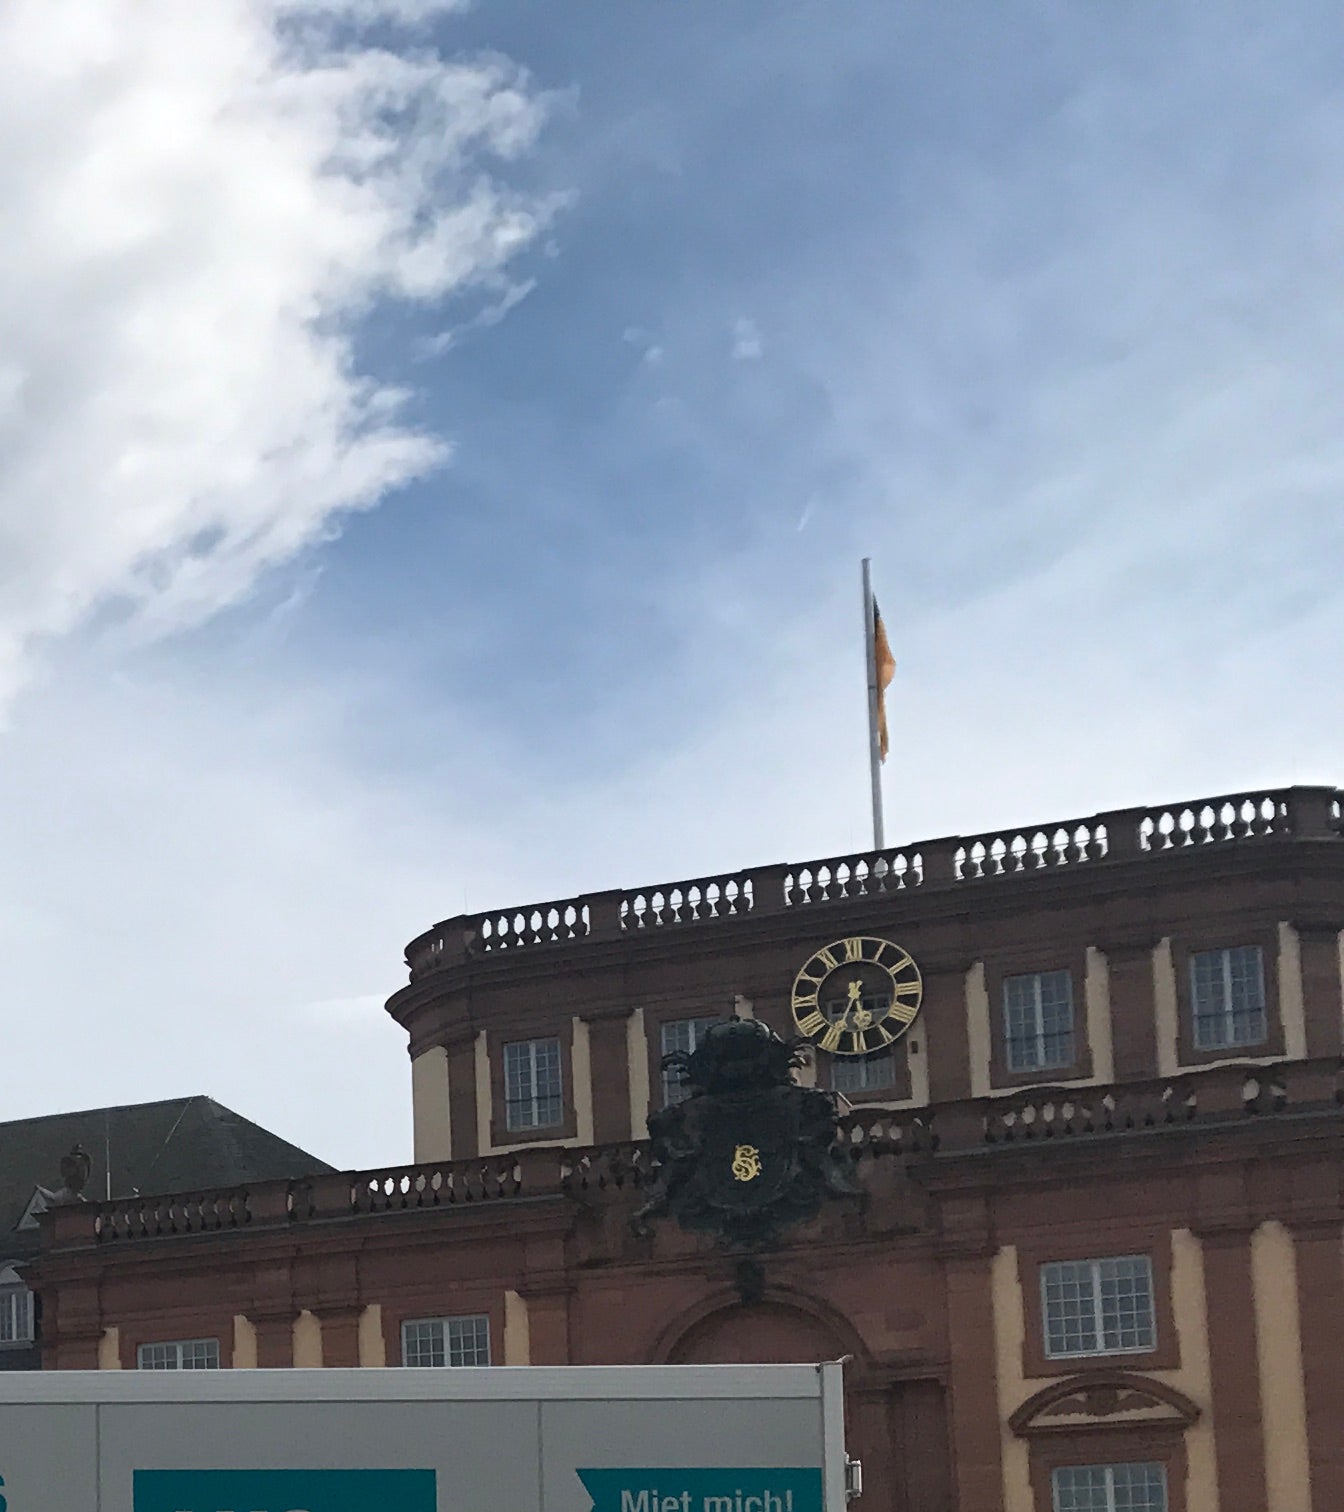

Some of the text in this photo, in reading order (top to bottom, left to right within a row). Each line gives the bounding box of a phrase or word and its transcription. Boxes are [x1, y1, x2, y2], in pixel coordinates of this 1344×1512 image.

[844, 939, 862, 961] XII
[873, 942, 886, 962] I
[889, 956, 912, 975] II
[799, 970, 822, 987] X
[896, 981, 920, 995] III
